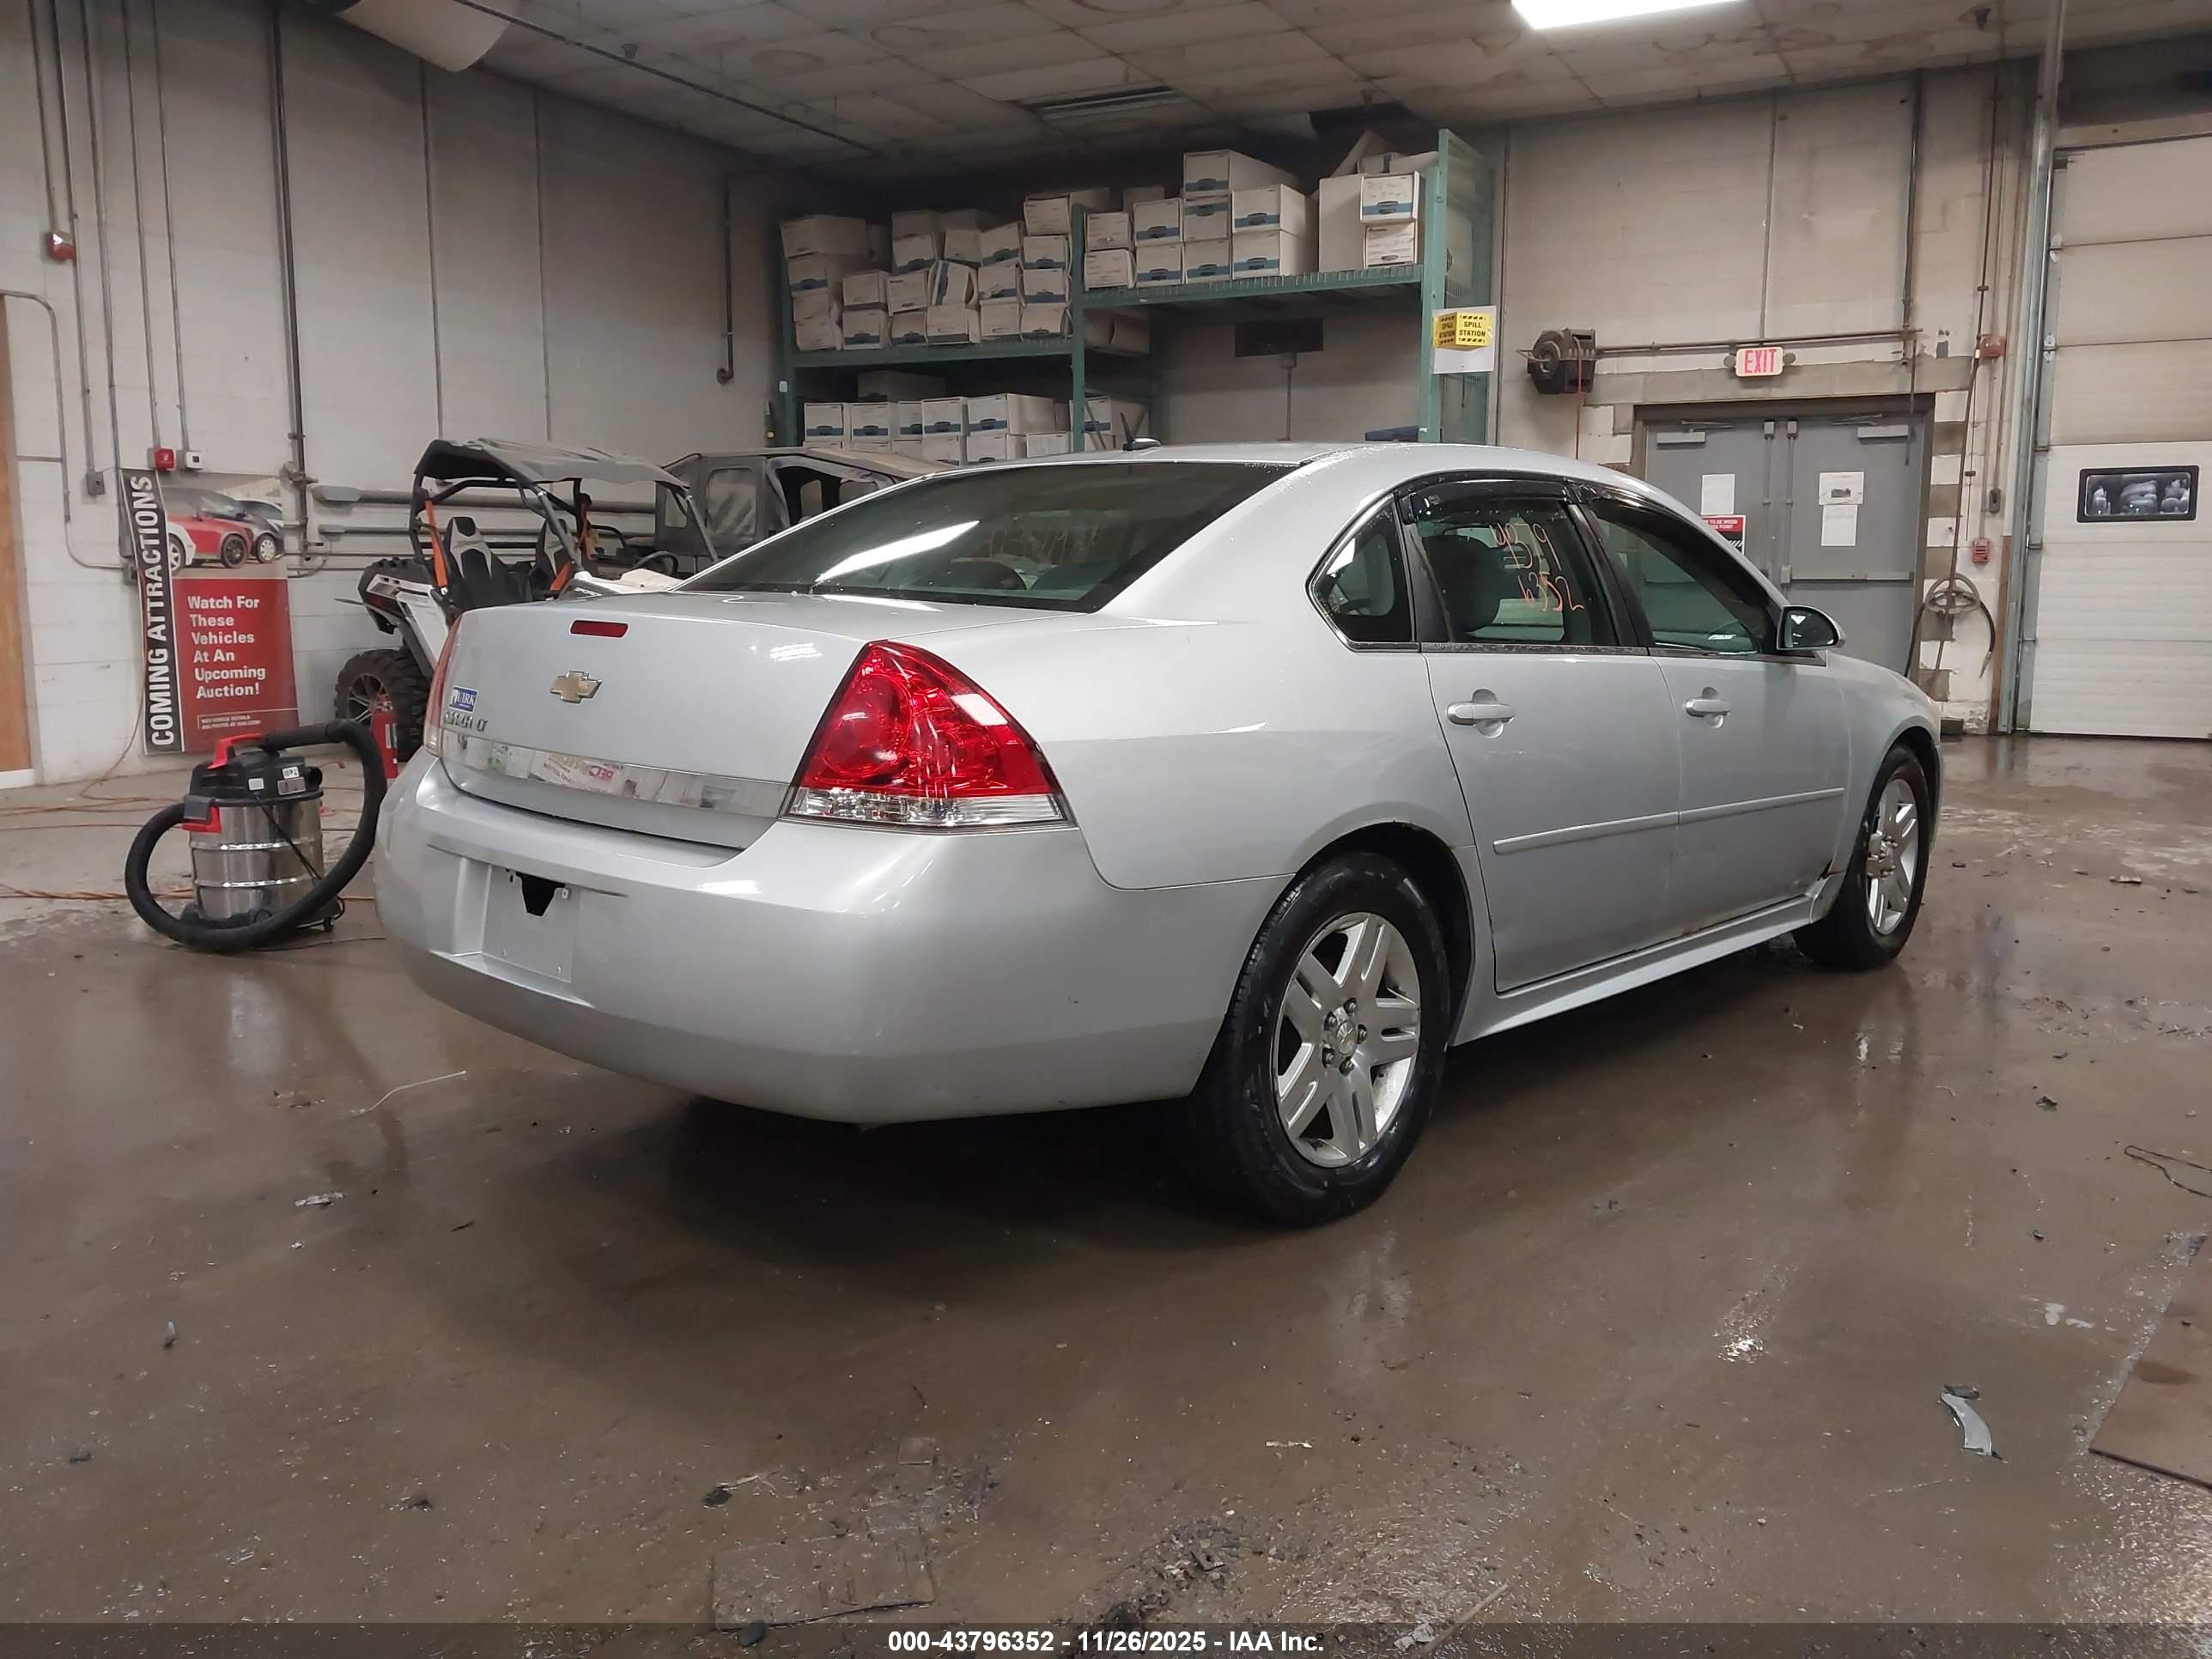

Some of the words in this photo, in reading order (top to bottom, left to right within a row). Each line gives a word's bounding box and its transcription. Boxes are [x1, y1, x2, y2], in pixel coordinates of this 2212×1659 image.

[1744, 349, 1777, 374] EXIT
[130, 475, 165, 641] ATTRACTIONS
[187, 596, 233, 609] Watch
[236, 595, 260, 609] For
[190, 614, 234, 627] These
[191, 631, 255, 645] Vehicles
[193, 650, 210, 663] At
[213, 648, 235, 662] An
[194, 665, 266, 683] Upcoming
[148, 648, 174, 746] COMING
[196, 682, 259, 699] Auction!
